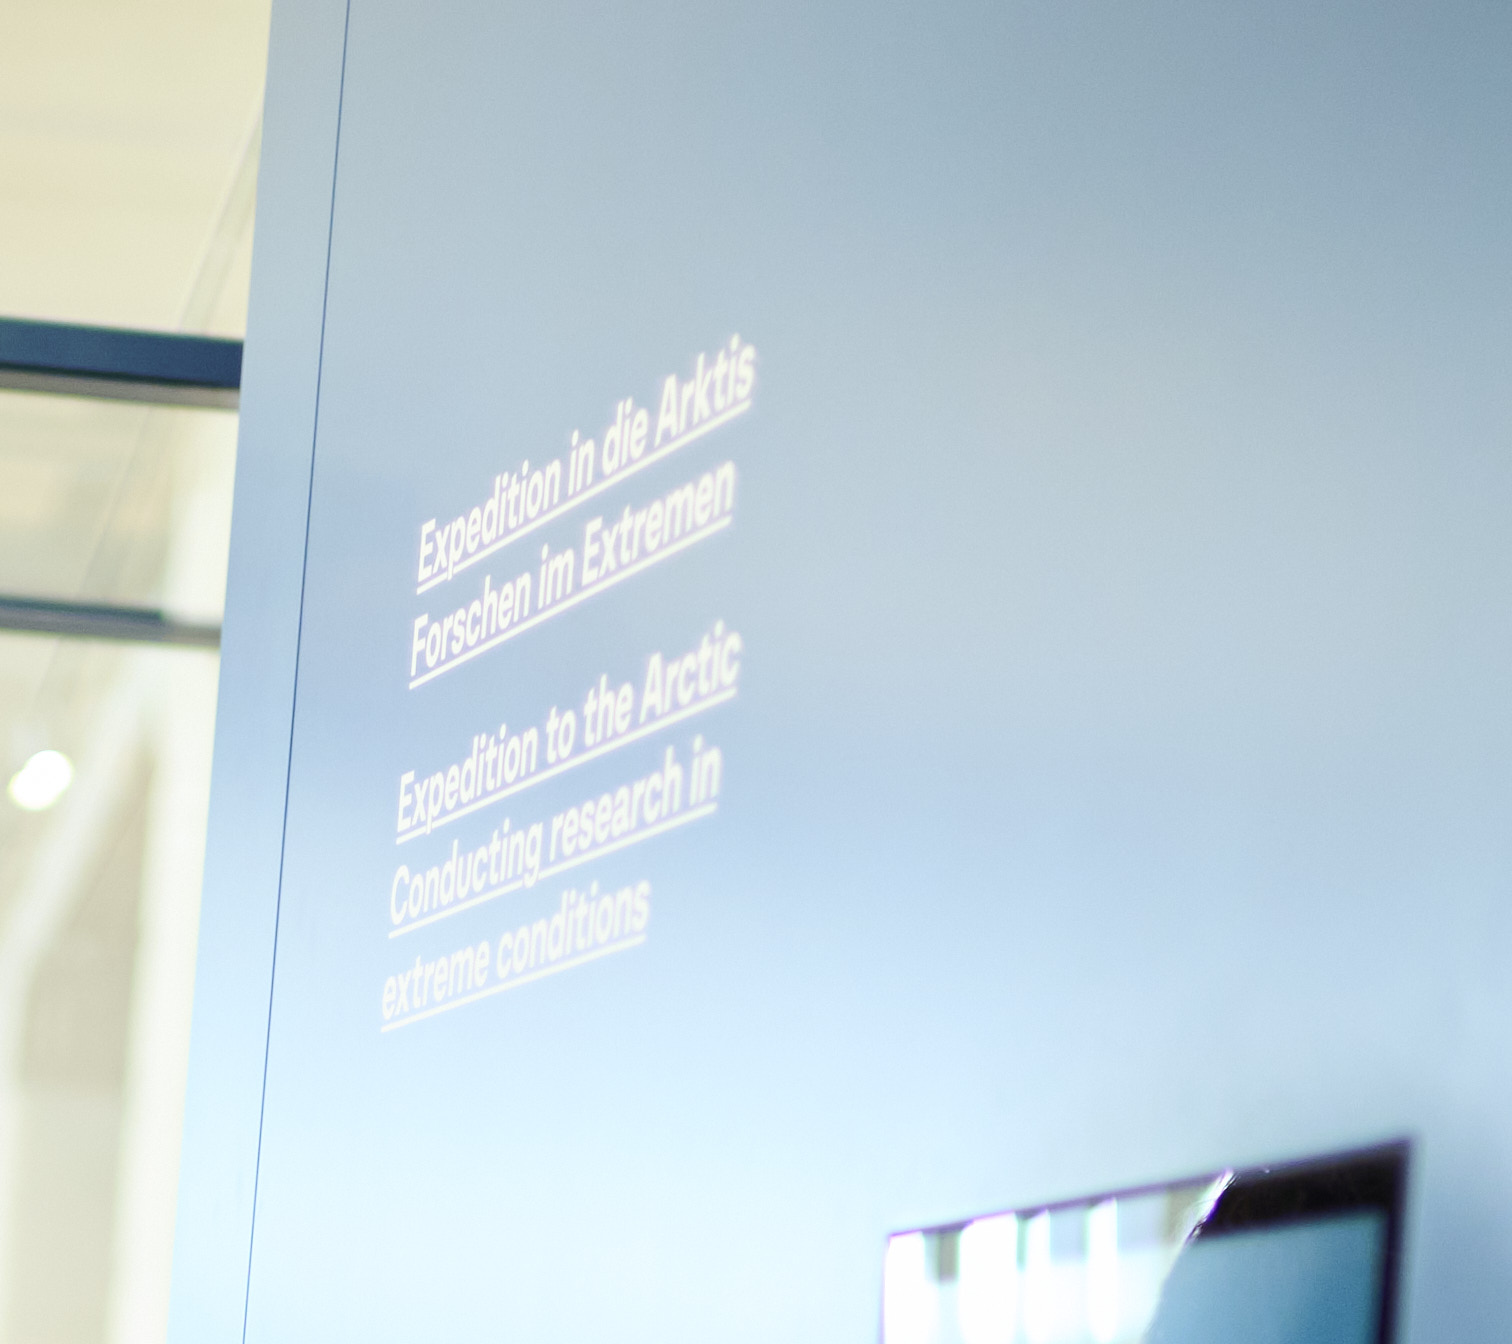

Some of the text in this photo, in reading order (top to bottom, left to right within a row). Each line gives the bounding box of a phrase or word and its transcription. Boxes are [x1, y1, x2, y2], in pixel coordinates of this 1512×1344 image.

[417, 333, 756, 581] Expedition in die Arktis
[410, 460, 737, 677] Forschen im Extremen
[389, 734, 723, 926] Conducting research in
[397, 619, 742, 835] Expedition to the Arctic
[381, 880, 651, 1021] extreme conditions
